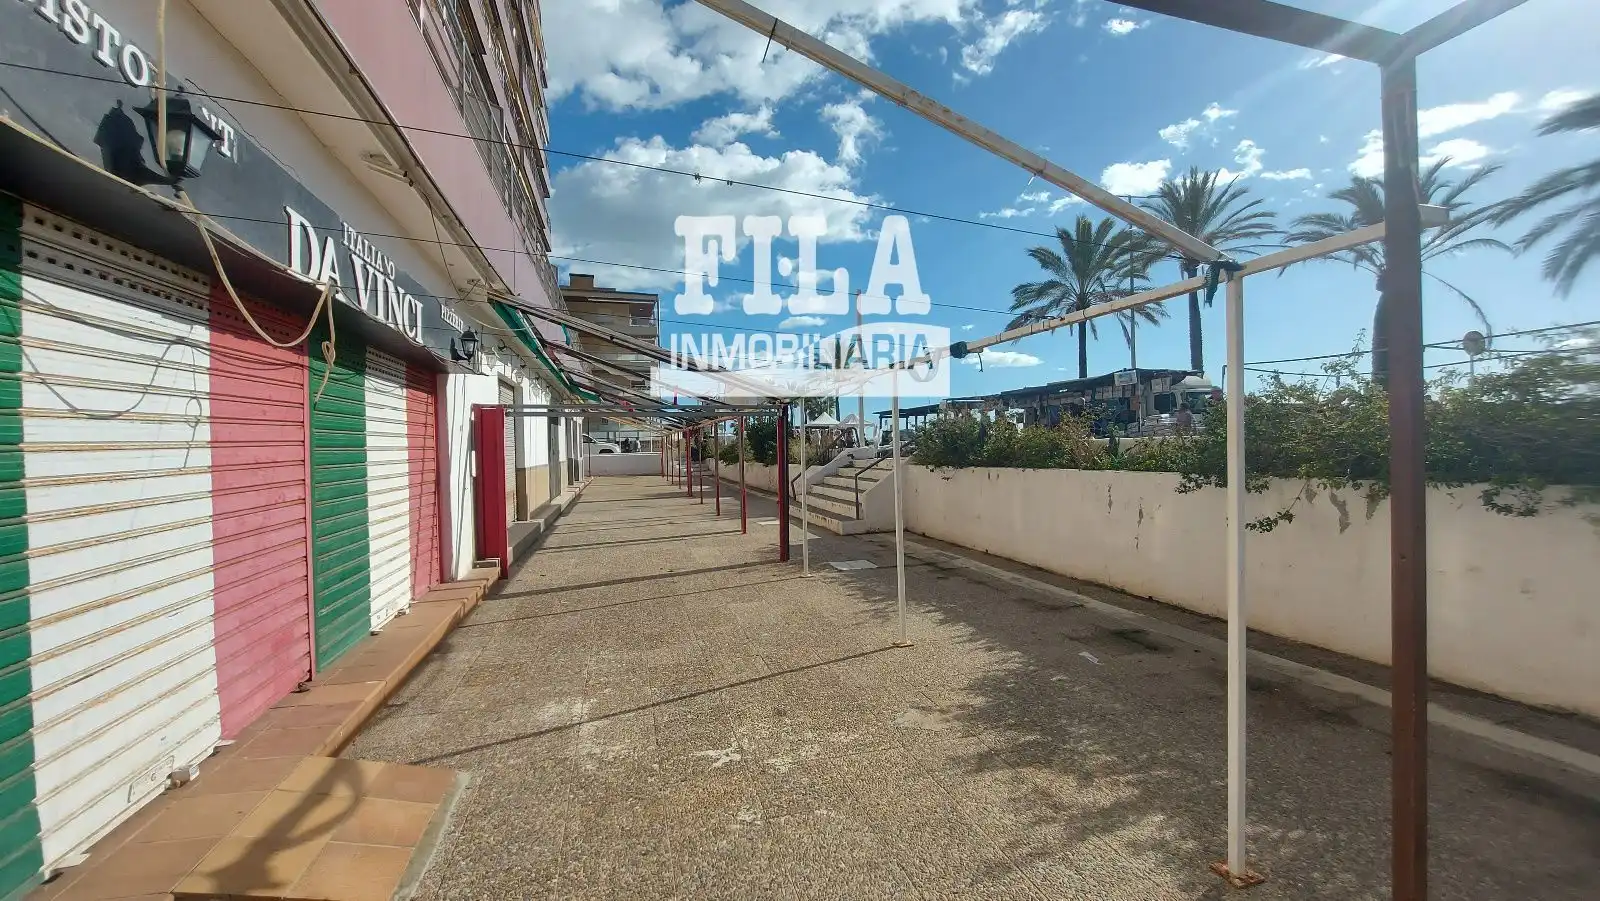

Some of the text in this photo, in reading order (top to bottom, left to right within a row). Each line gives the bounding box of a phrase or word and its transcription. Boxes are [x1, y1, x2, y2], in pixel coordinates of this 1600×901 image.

[285, 206, 423, 344] DA VINCI
[342, 221, 395, 280] ITALIANO
